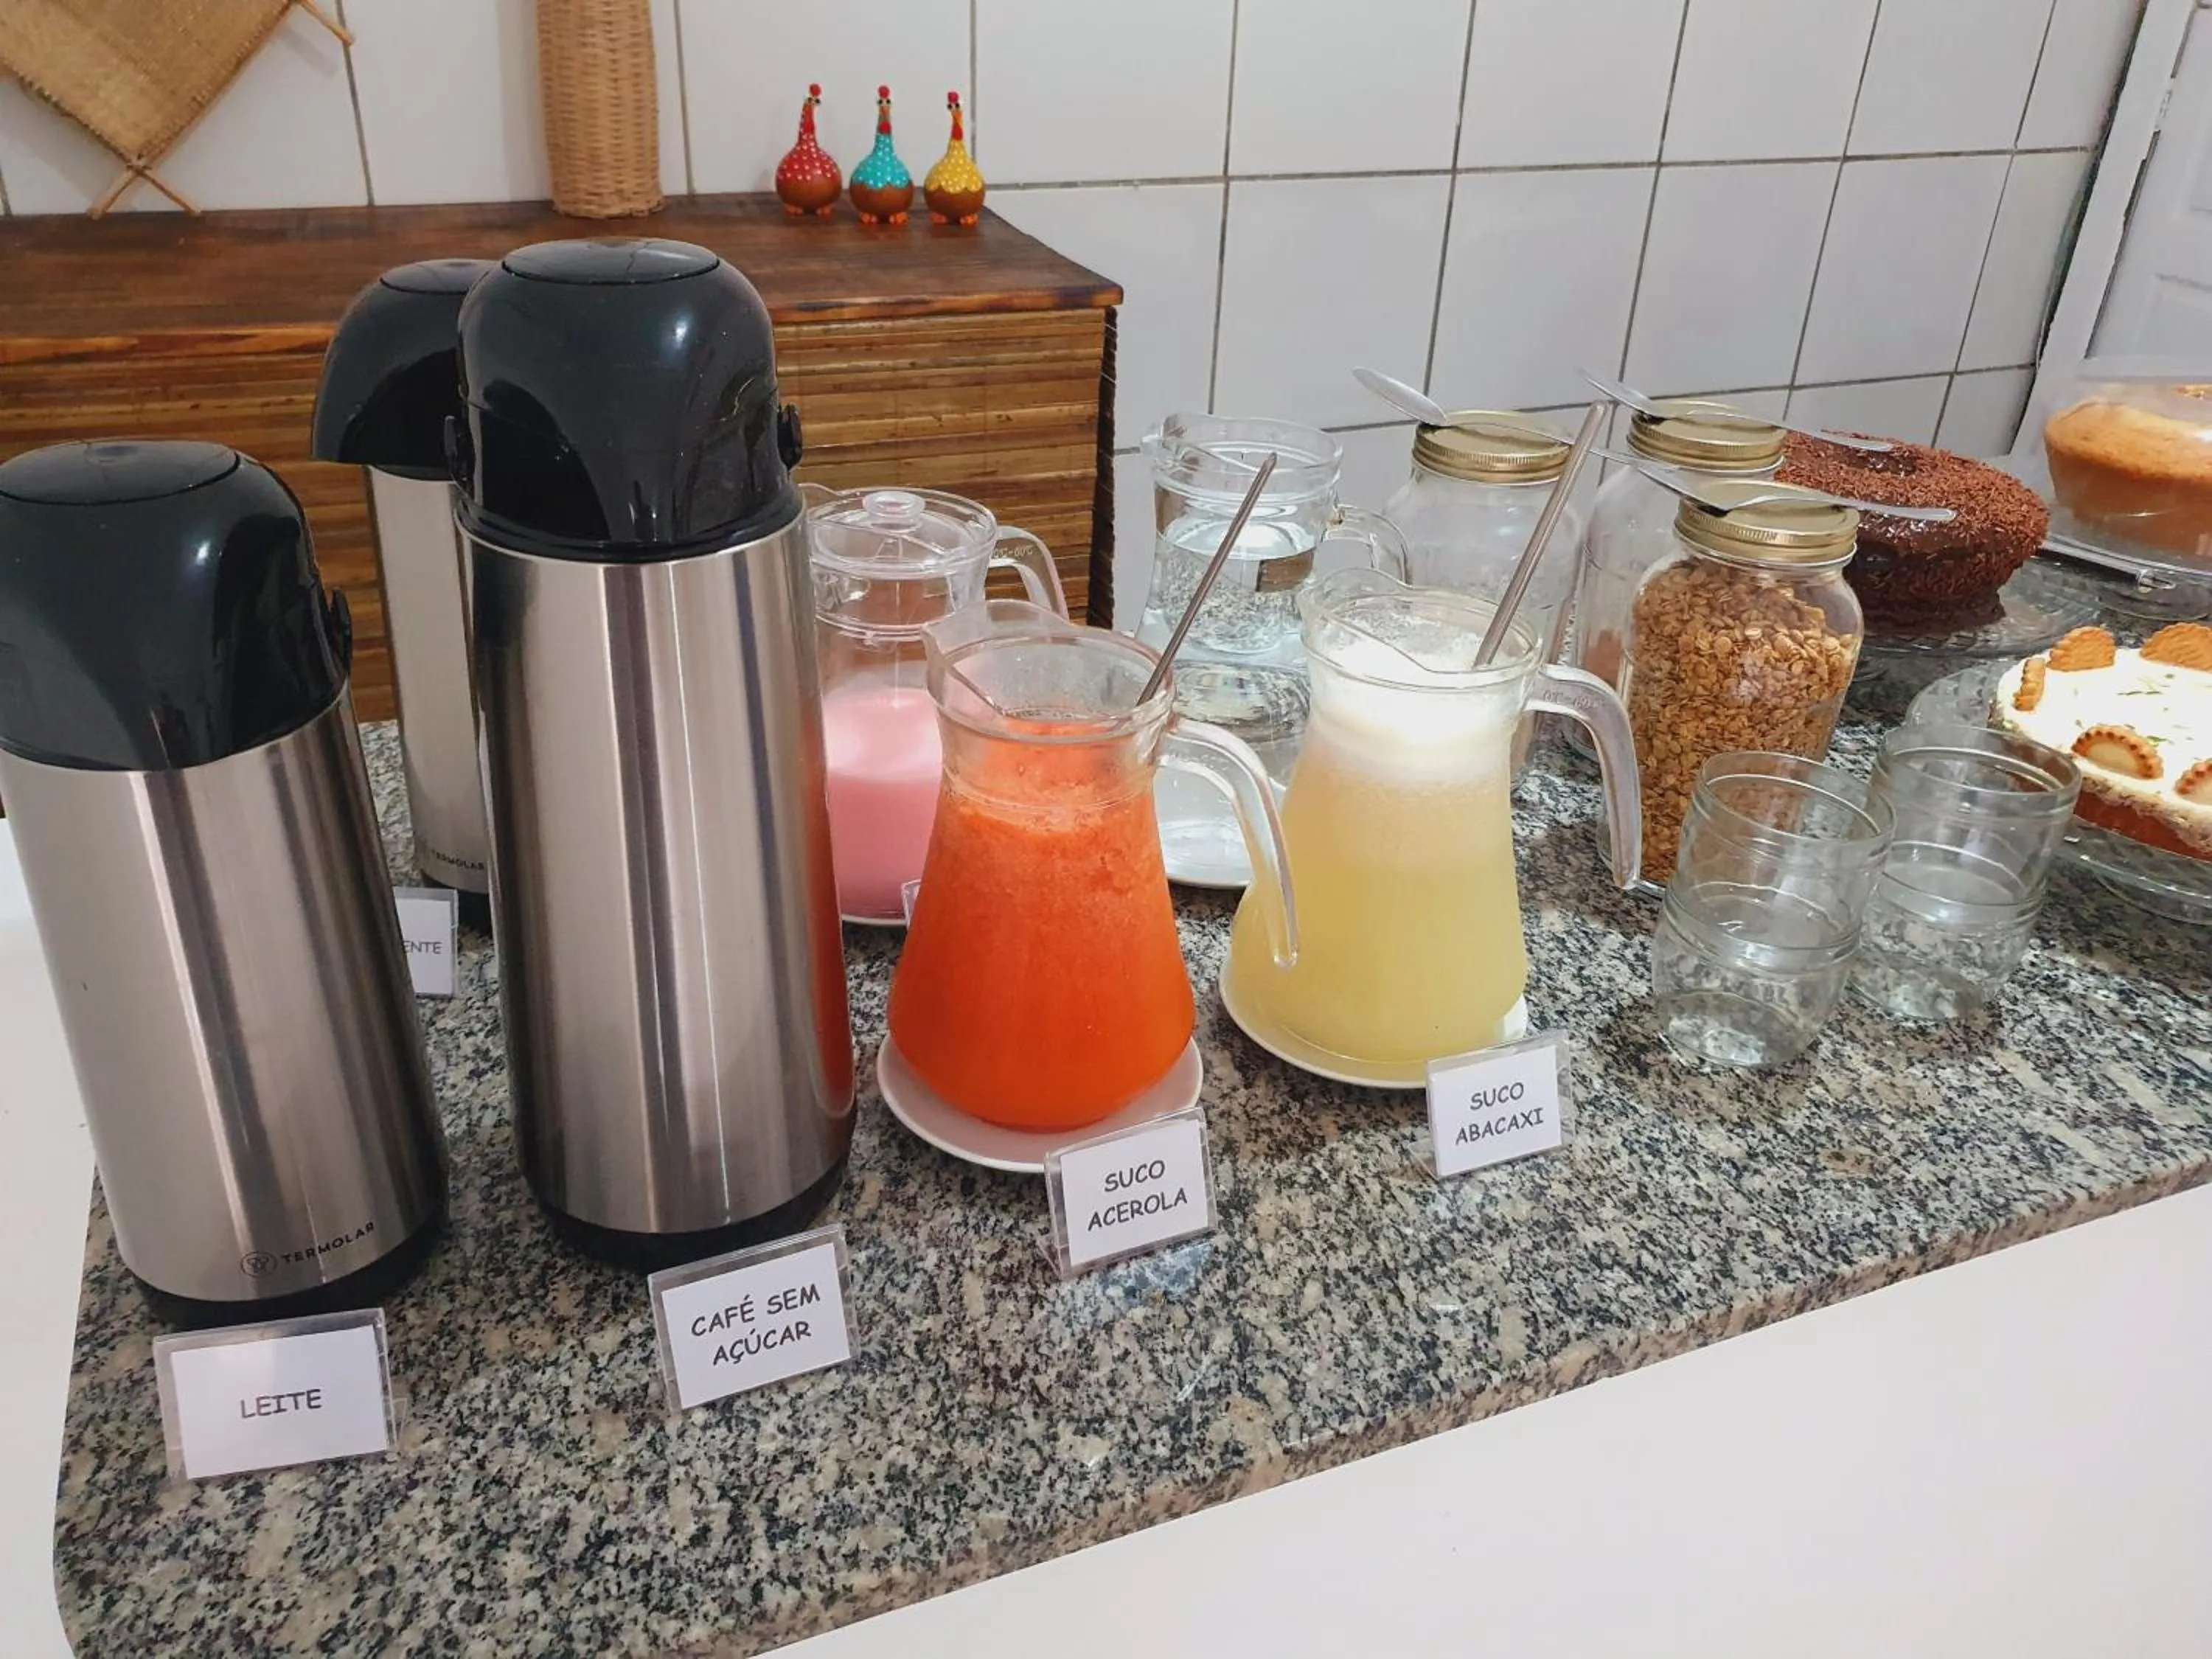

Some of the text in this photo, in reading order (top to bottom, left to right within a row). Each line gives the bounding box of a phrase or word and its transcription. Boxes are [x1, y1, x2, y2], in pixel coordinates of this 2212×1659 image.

[1469, 1082, 1525, 1110] SUCO
[1455, 1107, 1545, 1146] ABACAXI
[1105, 1160, 1165, 1192] SUCO
[1088, 1187, 1188, 1231] ACEROLA
[282, 1221, 375, 1263] TERMOLAR
[691, 1283, 821, 1337] CAFÉ SEM
[712, 1321, 812, 1366] AÇÚCAR
[240, 1388, 323, 1419] LEITE
